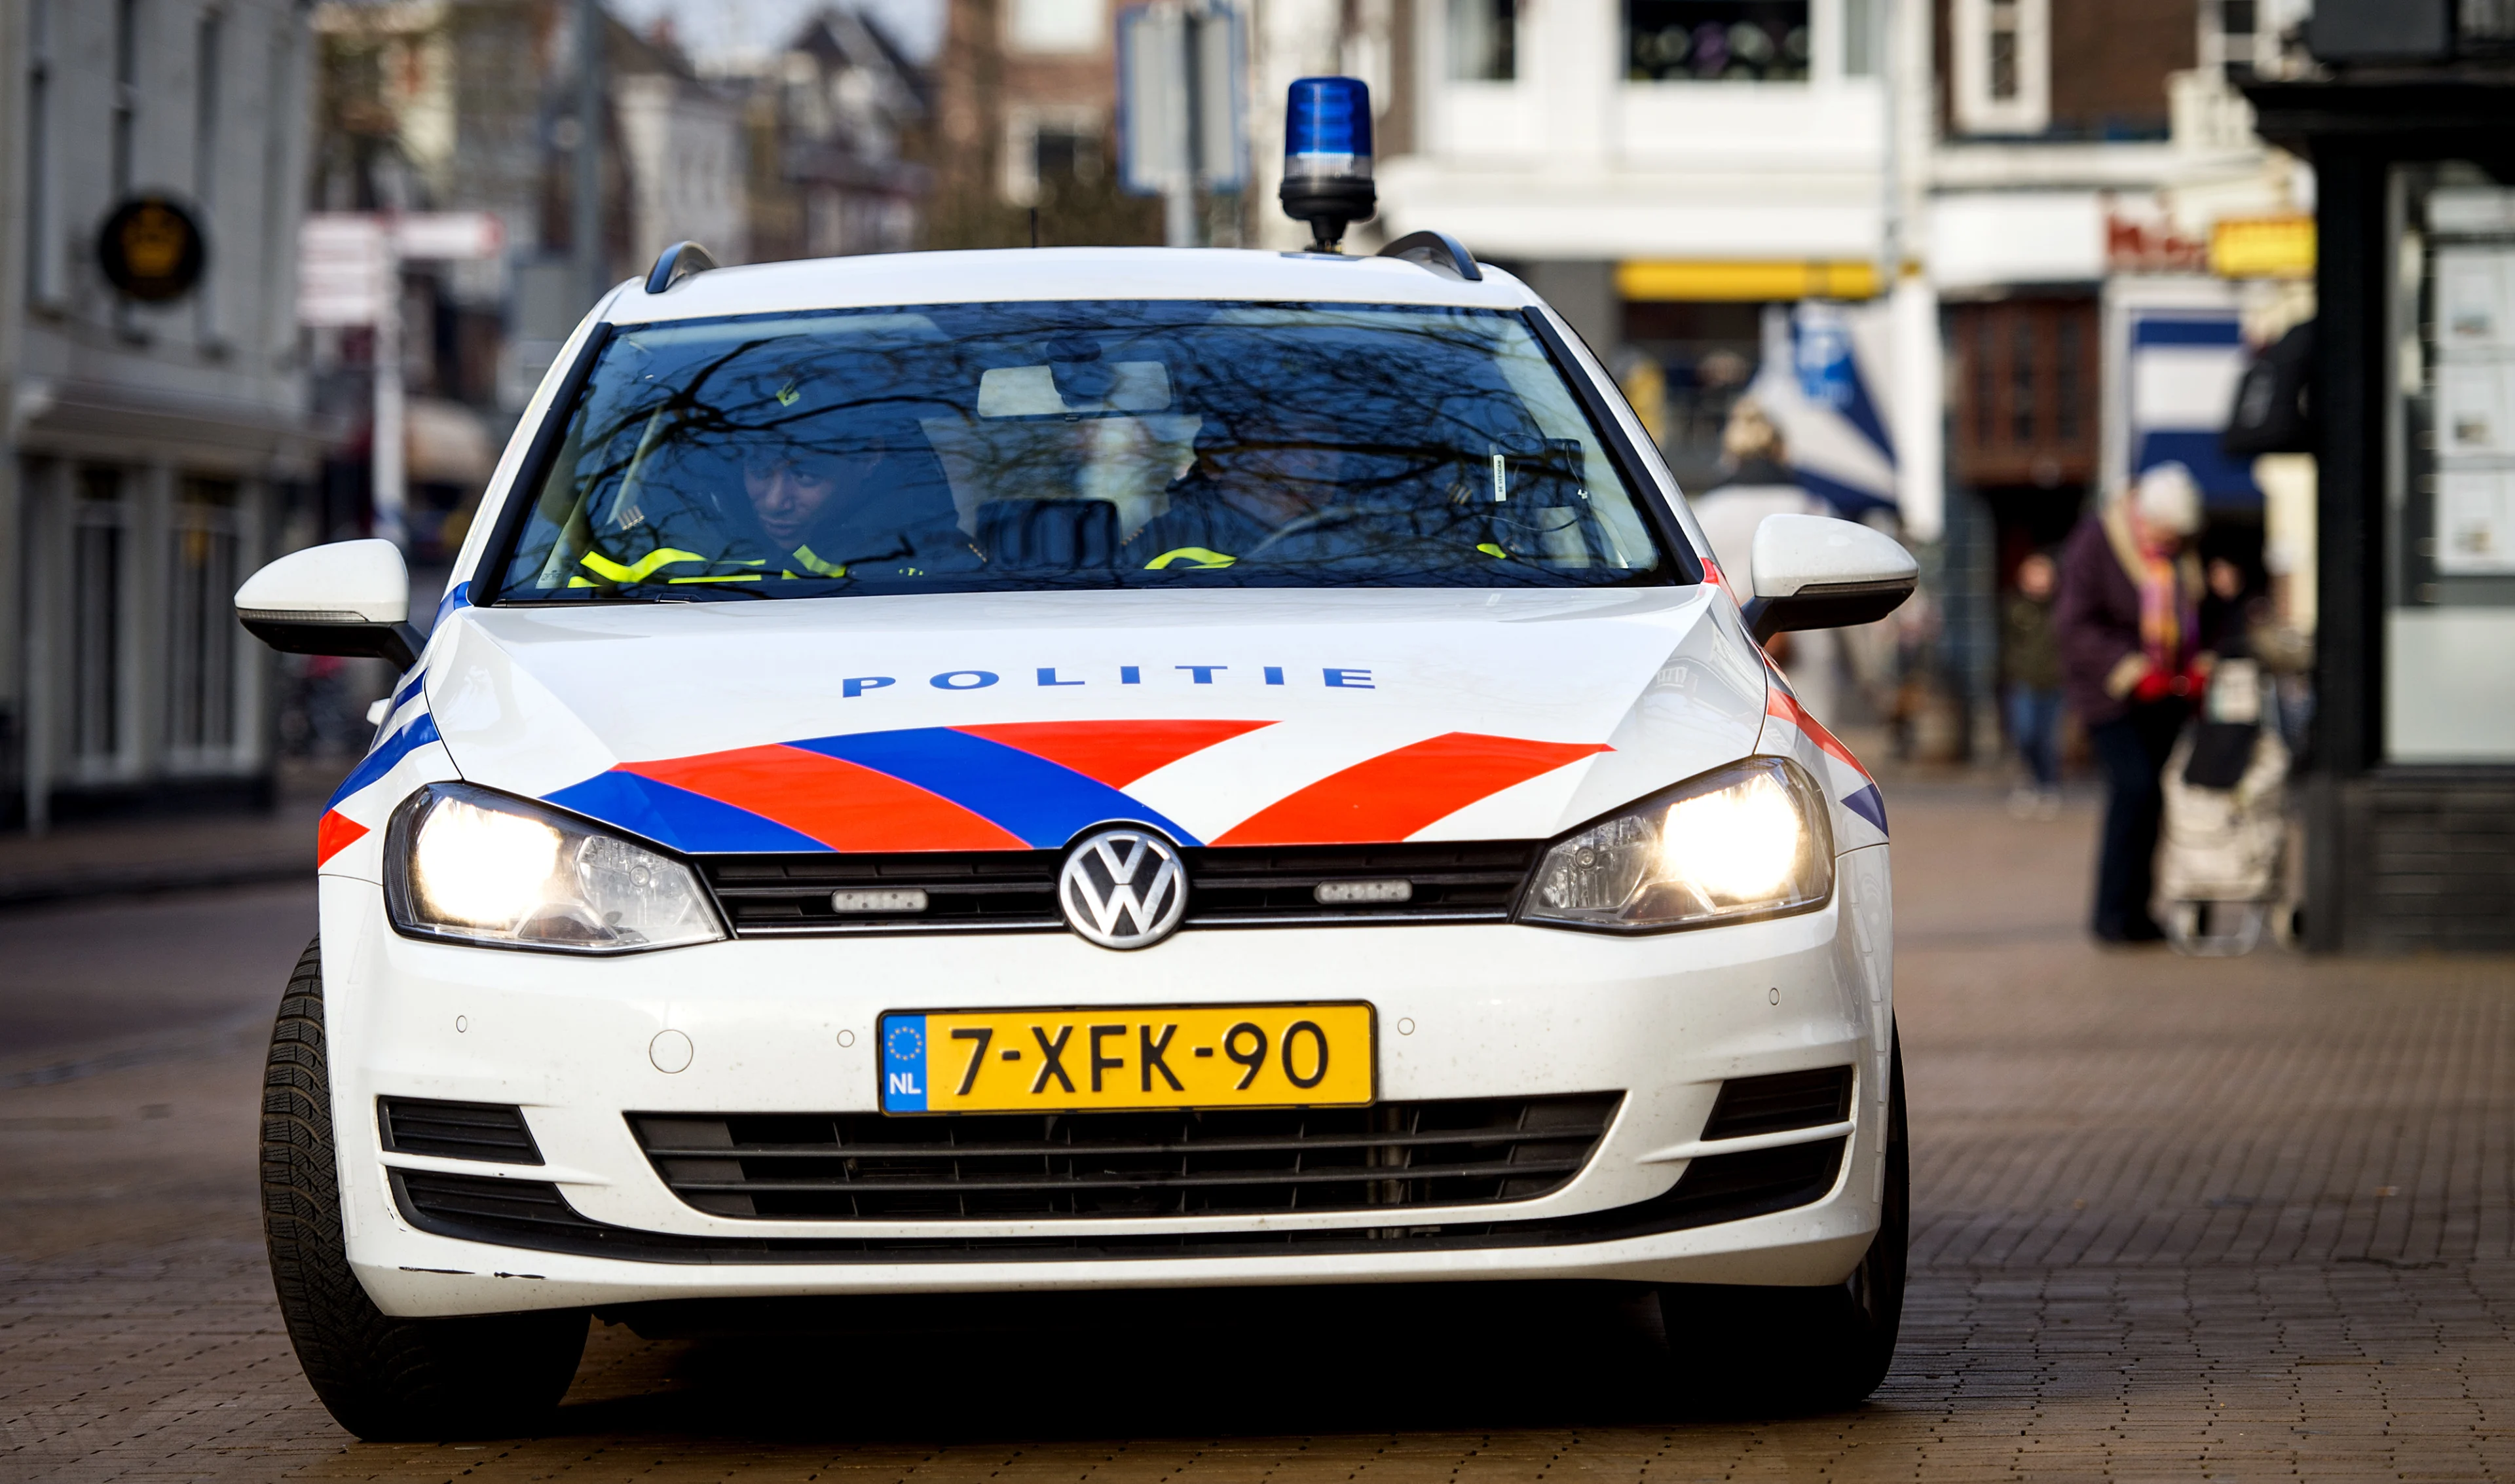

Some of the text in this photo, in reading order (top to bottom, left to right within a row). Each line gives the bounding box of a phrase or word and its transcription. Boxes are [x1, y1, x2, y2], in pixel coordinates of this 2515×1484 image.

[842, 665, 1376, 698] POLITIE
[1066, 832, 1180, 942] VW
[889, 1073, 922, 1094] NL
[950, 1020, 1330, 1096] 7-XFK-90
